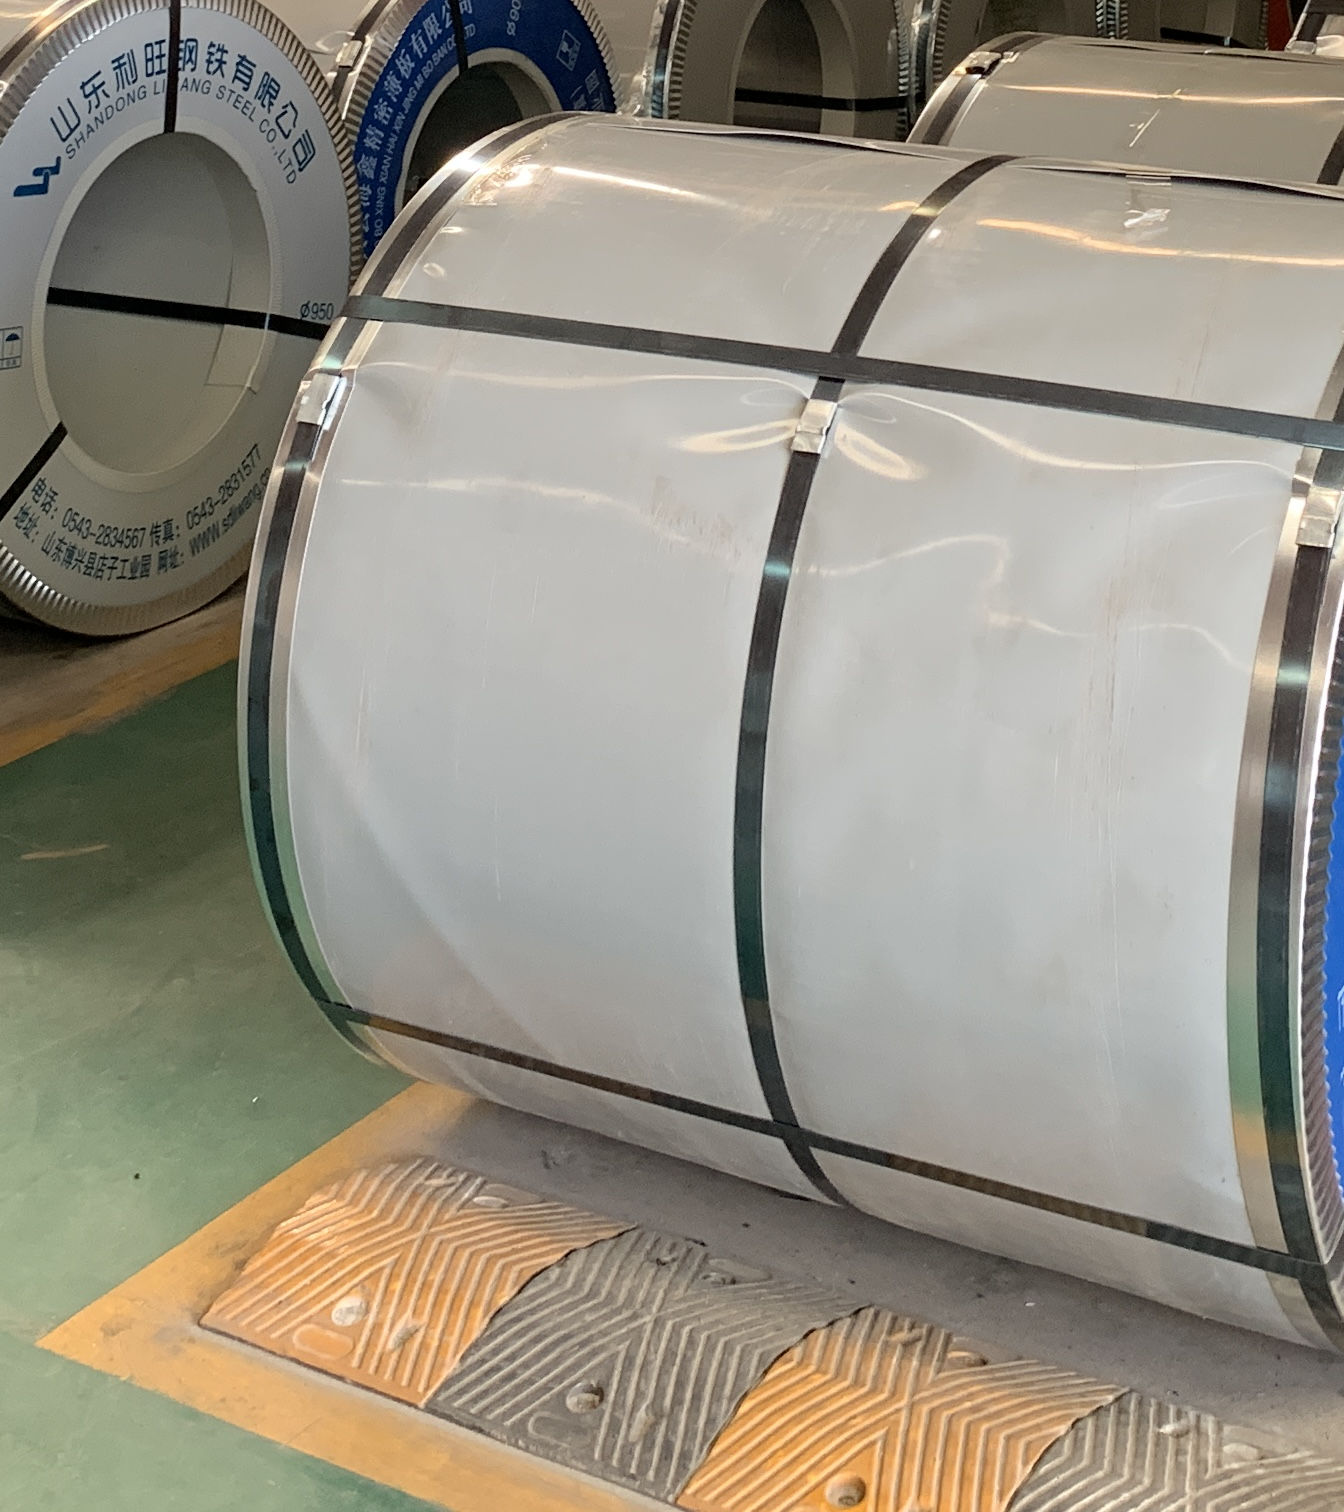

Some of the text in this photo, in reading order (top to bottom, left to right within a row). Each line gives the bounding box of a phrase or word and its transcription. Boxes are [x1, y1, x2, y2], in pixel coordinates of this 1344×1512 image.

[65, 85, 147, 160] SHANDONG
[153, 76, 211, 97] LIANG
[215, 85, 256, 123] STEEL
